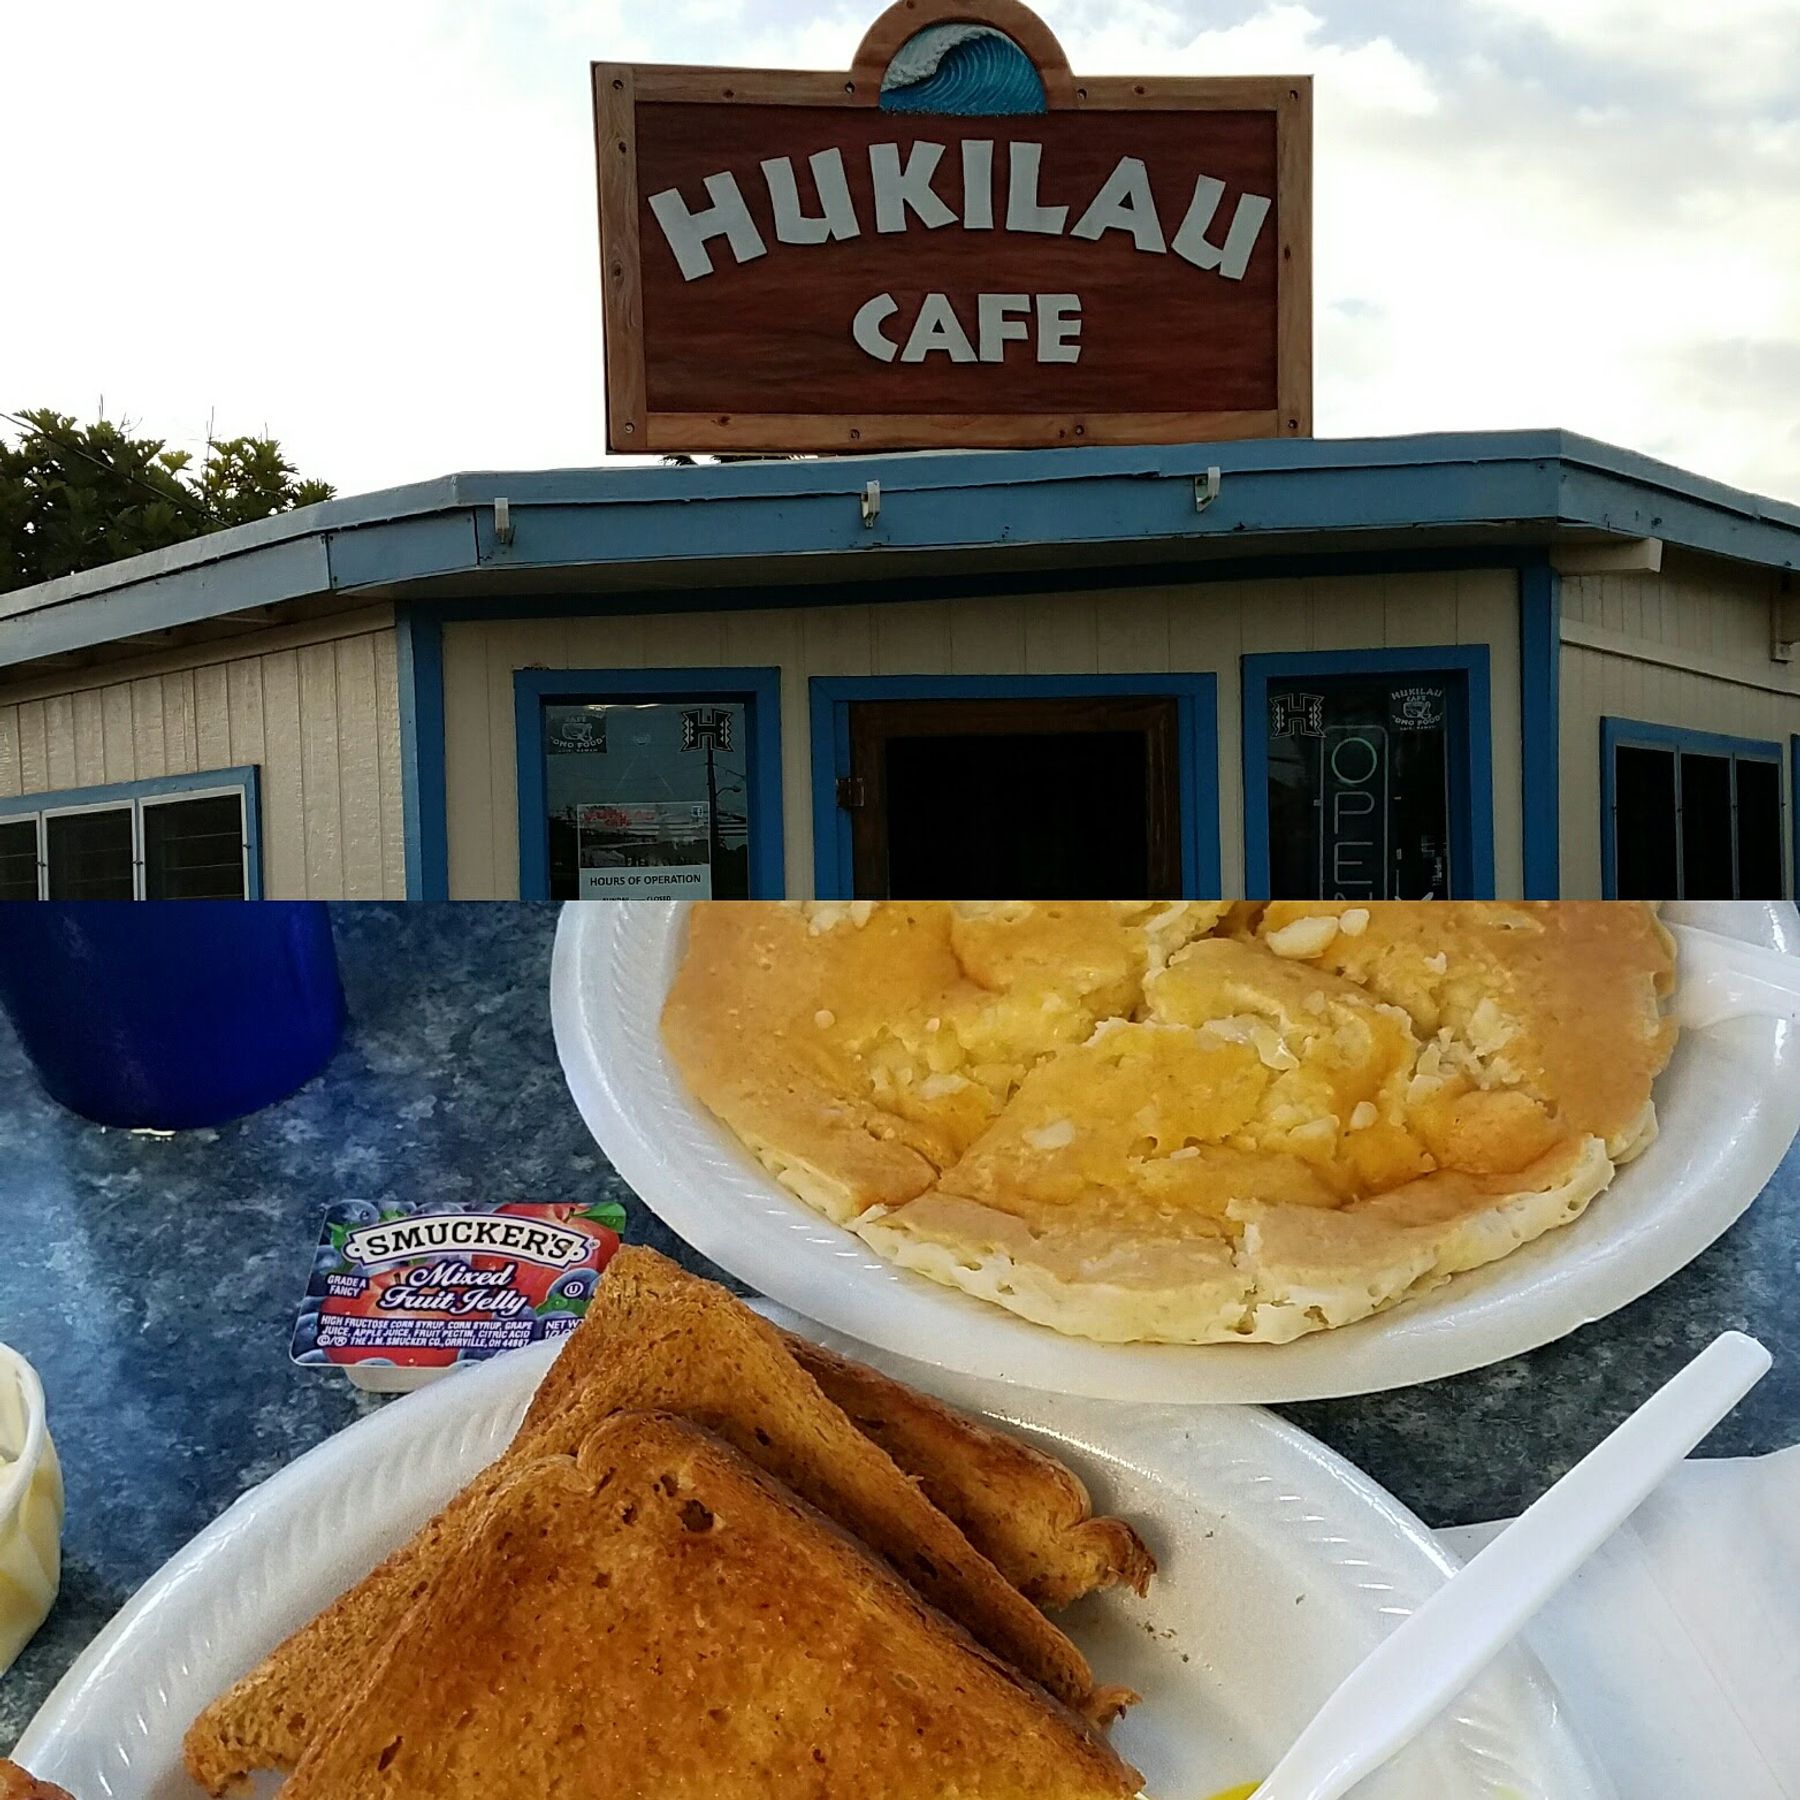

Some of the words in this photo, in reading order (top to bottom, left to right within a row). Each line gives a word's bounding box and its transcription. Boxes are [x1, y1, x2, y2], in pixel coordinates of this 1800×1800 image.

[648, 139, 1271, 281] HUKILAU
[853, 293, 1082, 363] CAFE
[1391, 687, 1442, 700] HUKILAU
[1331, 737, 1378, 900] OPE
[590, 876, 625, 886] HOURS
[628, 876, 642, 885] OF
[643, 874, 701, 885] OPERATION
[366, 1221, 575, 1259] SMUCKER'S
[327, 1274, 359, 1288] GRADE
[359, 1278, 367, 1289] A
[409, 1260, 515, 1288] Mixed
[329, 1284, 360, 1297] FANCY
[380, 1287, 455, 1312] Fruit
[454, 1288, 528, 1316] Jelly
[320, 1315, 345, 1326] HIGH
[344, 1317, 388, 1329] FRUCTOSE
[390, 1321, 414, 1329] CORN
[448, 1321, 473, 1329] CORN
[504, 1321, 533, 1330] GRAPE
[545, 1320, 566, 1330] NET
[322, 1325, 351, 1337] JUICE,
[352, 1328, 384, 1338] APPLE
[383, 1329, 411, 1339] JUICE,
[413, 1329, 440, 1338] FRUIT
[441, 1330, 476, 1339] PECTIN,
[478, 1329, 508, 1338] CITRIC
[509, 1330, 531, 1339] ACID
[350, 1337, 367, 1346] THE
[386, 1337, 427, 1347] SMUCKER
[489, 1338, 502, 1347] OH
